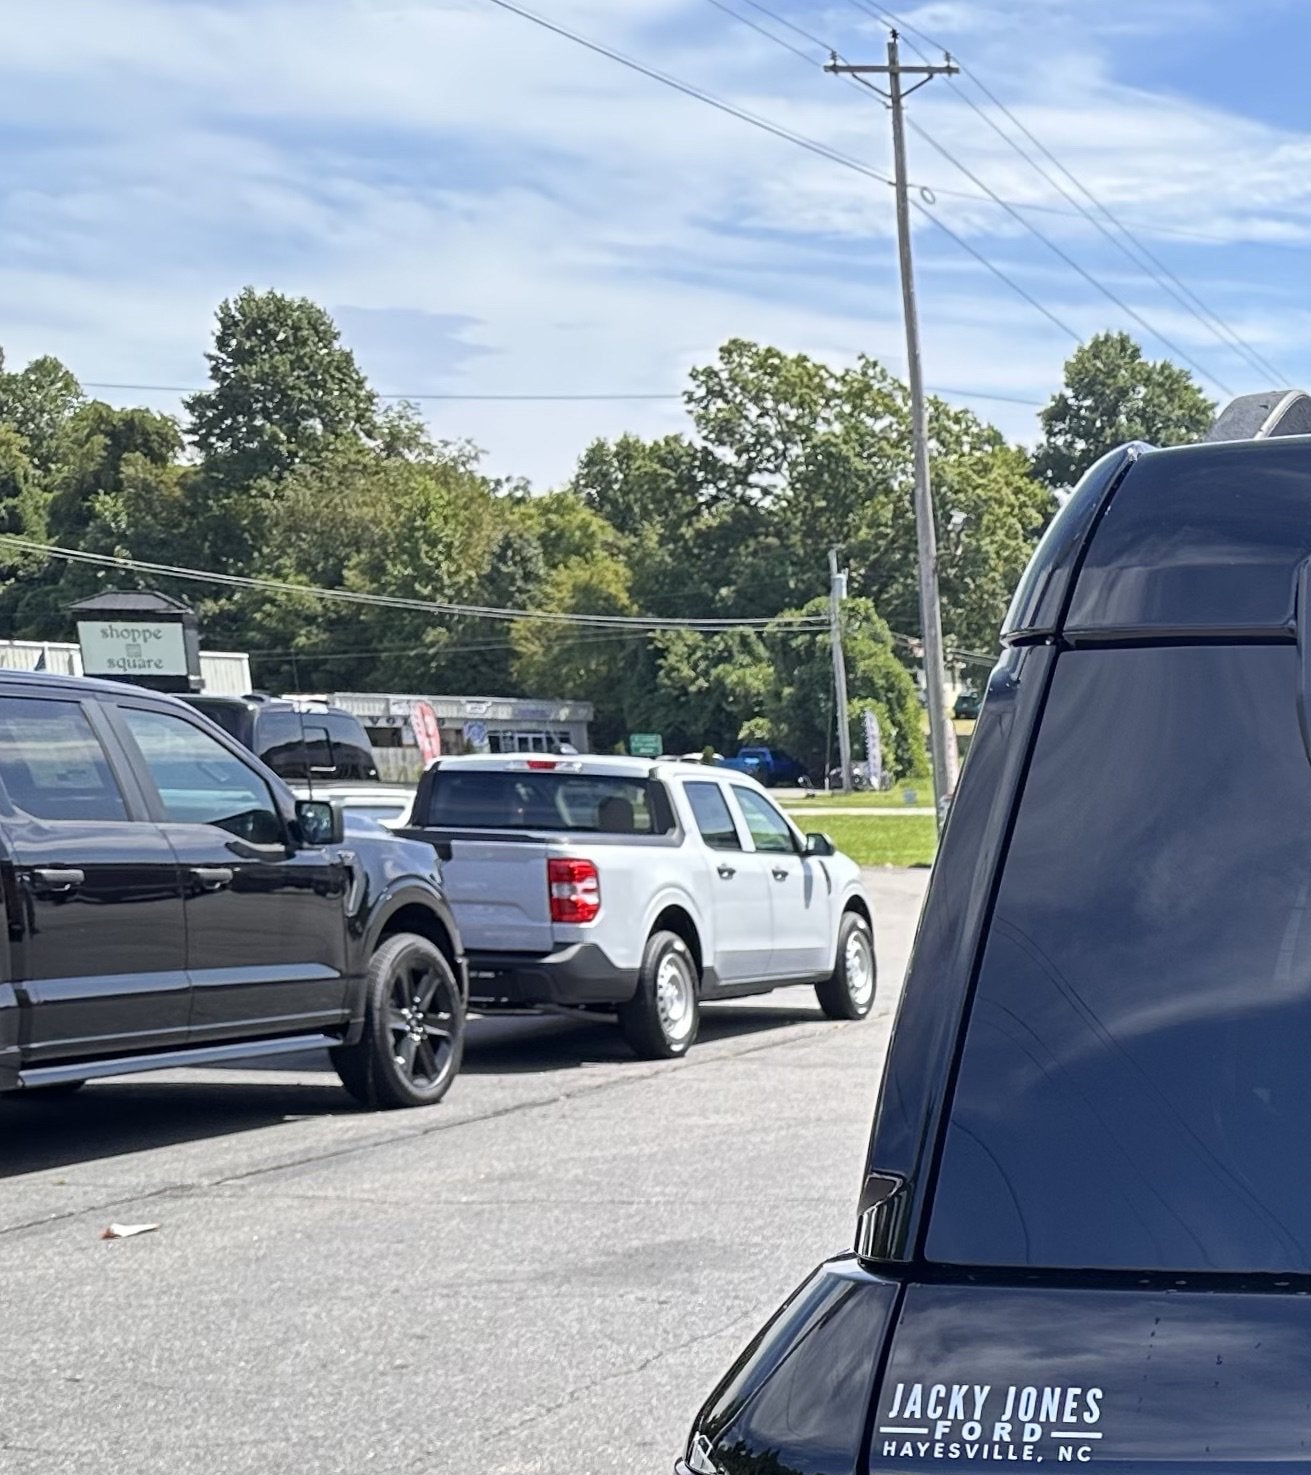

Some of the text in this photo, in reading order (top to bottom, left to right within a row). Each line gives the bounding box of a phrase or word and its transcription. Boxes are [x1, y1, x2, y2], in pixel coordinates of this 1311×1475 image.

[100, 624, 163, 643] shoppe
[107, 657, 164, 672] square
[888, 1383, 1104, 1424] JACKY JONES
[934, 1420, 1042, 1442] FORD
[883, 1441, 1092, 1463] HAYESVILLE, NC
